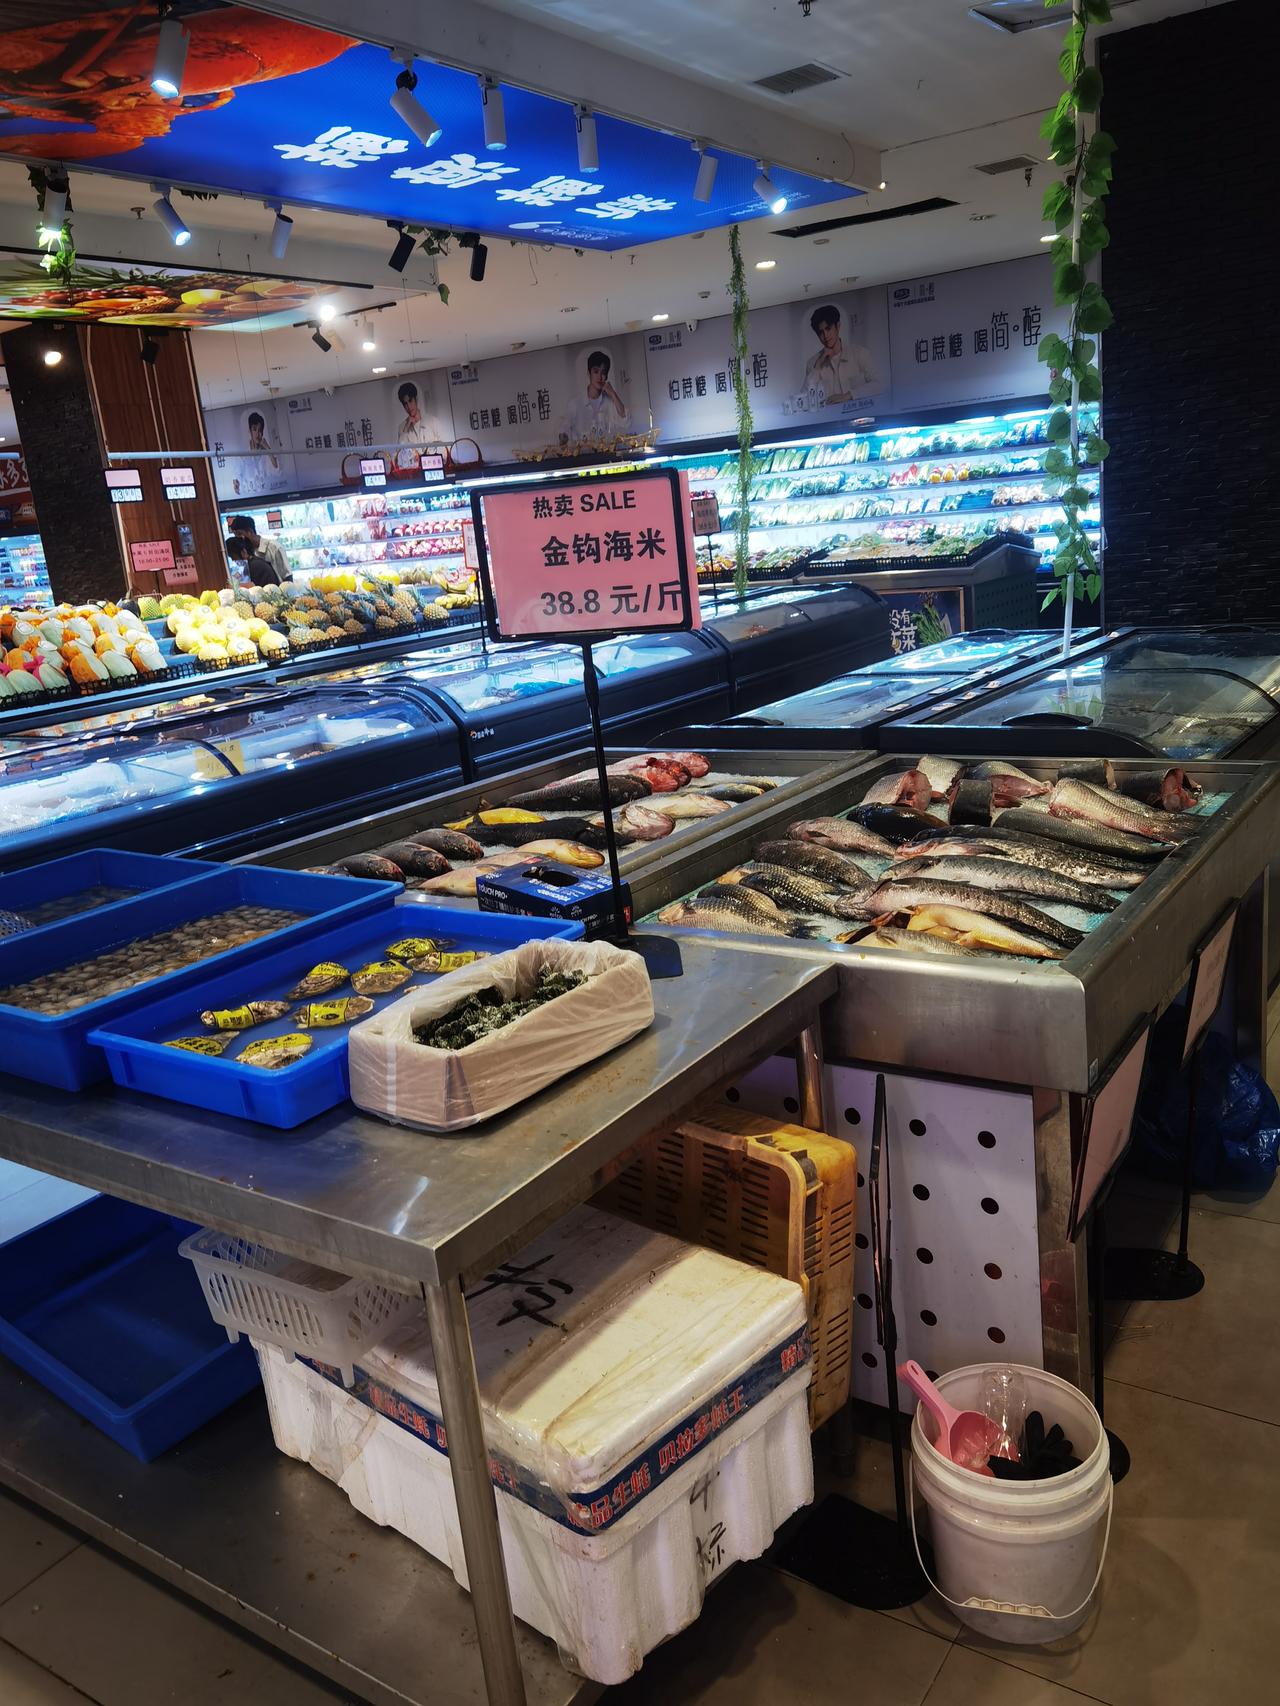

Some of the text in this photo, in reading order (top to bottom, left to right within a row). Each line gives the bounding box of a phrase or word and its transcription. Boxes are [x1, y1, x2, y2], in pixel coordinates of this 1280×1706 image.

[532, 490, 637, 519] 热卖 SALE
[541, 528, 667, 567] 金钩海米
[540, 580, 682, 616] 38.8 元/斤
[658, 1385, 745, 1475] 贝拉多蚝王
